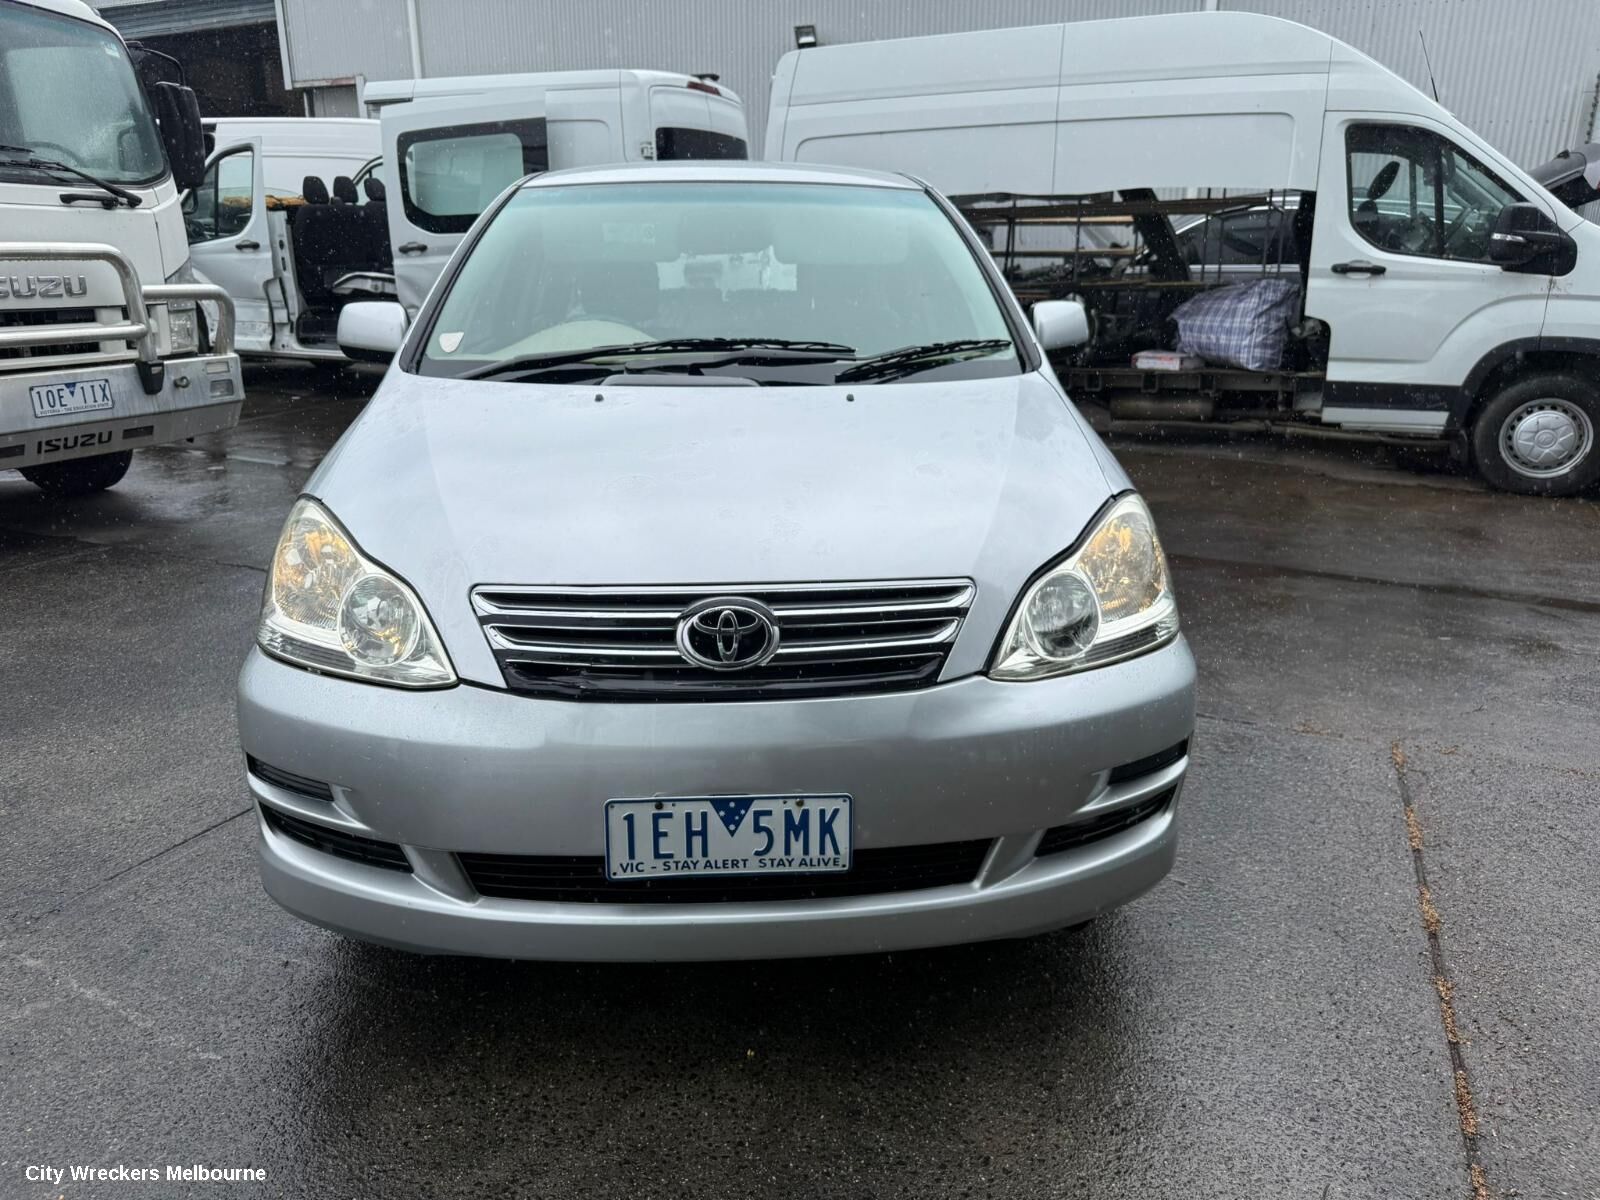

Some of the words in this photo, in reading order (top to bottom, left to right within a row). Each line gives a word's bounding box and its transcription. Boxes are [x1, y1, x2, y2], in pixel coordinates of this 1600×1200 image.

[37, 430, 113, 454] ISUZU
[622, 810, 709, 861] 1EH
[752, 807, 841, 857] 5MK
[620, 861, 645, 873] VIC
[663, 860, 699, 871] STAY
[703, 858, 749, 870] ALERT
[758, 857, 795, 868] STAY
[798, 857, 841, 868] ALIVE
